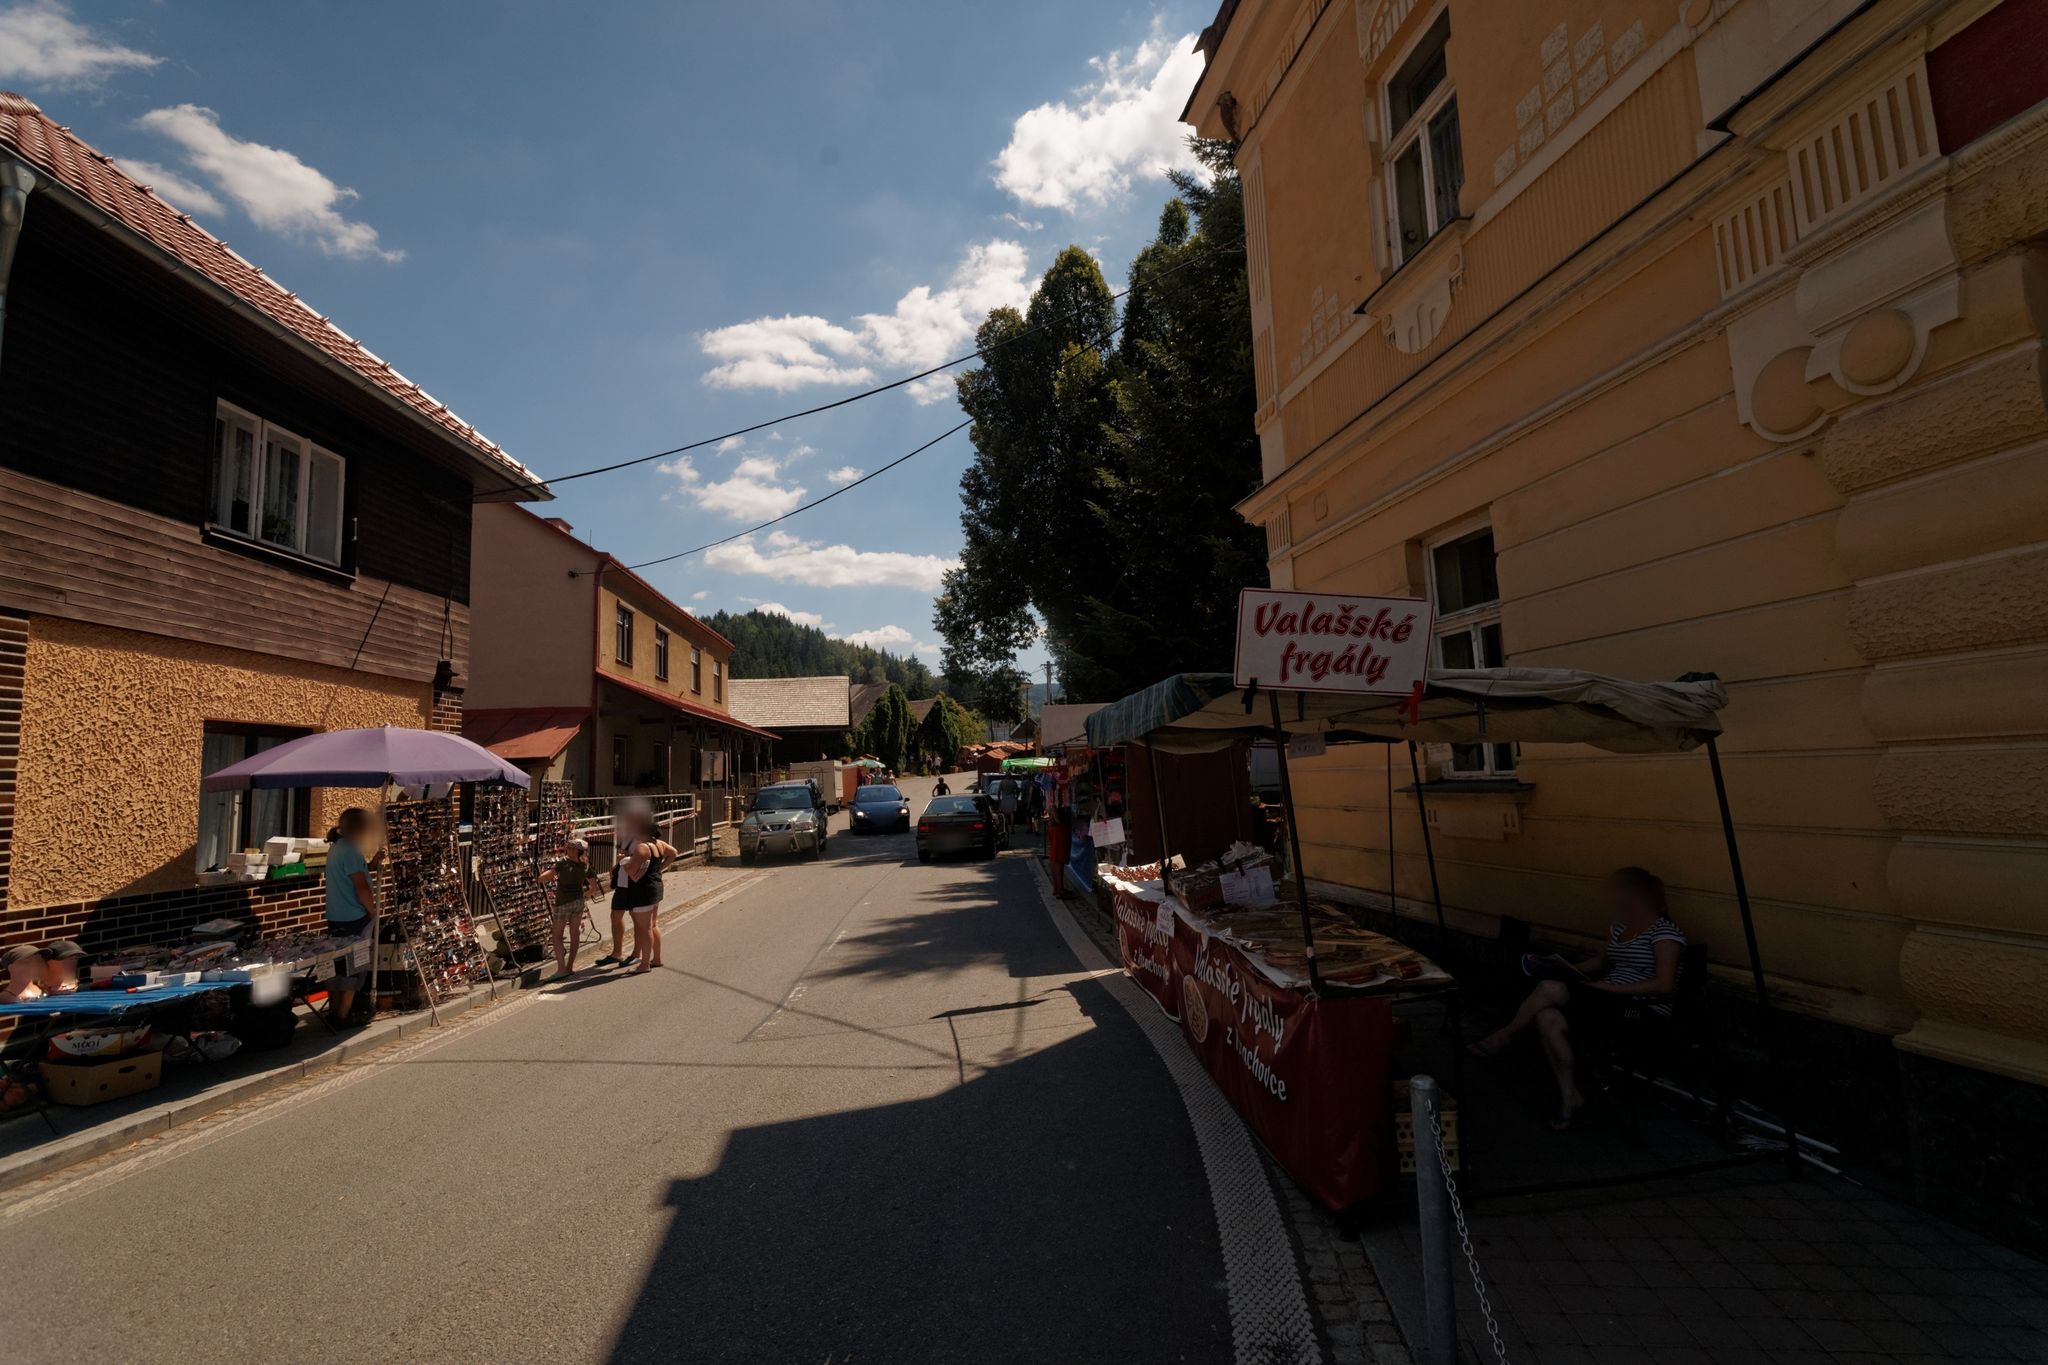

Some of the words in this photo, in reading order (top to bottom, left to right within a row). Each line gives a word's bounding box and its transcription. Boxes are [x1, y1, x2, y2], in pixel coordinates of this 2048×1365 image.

[1255, 602, 1417, 642] Valašské
[1280, 640, 1391, 684] frgály
[1241, 972, 1286, 1056] frgály
[1226, 1025, 1234, 1046] z
